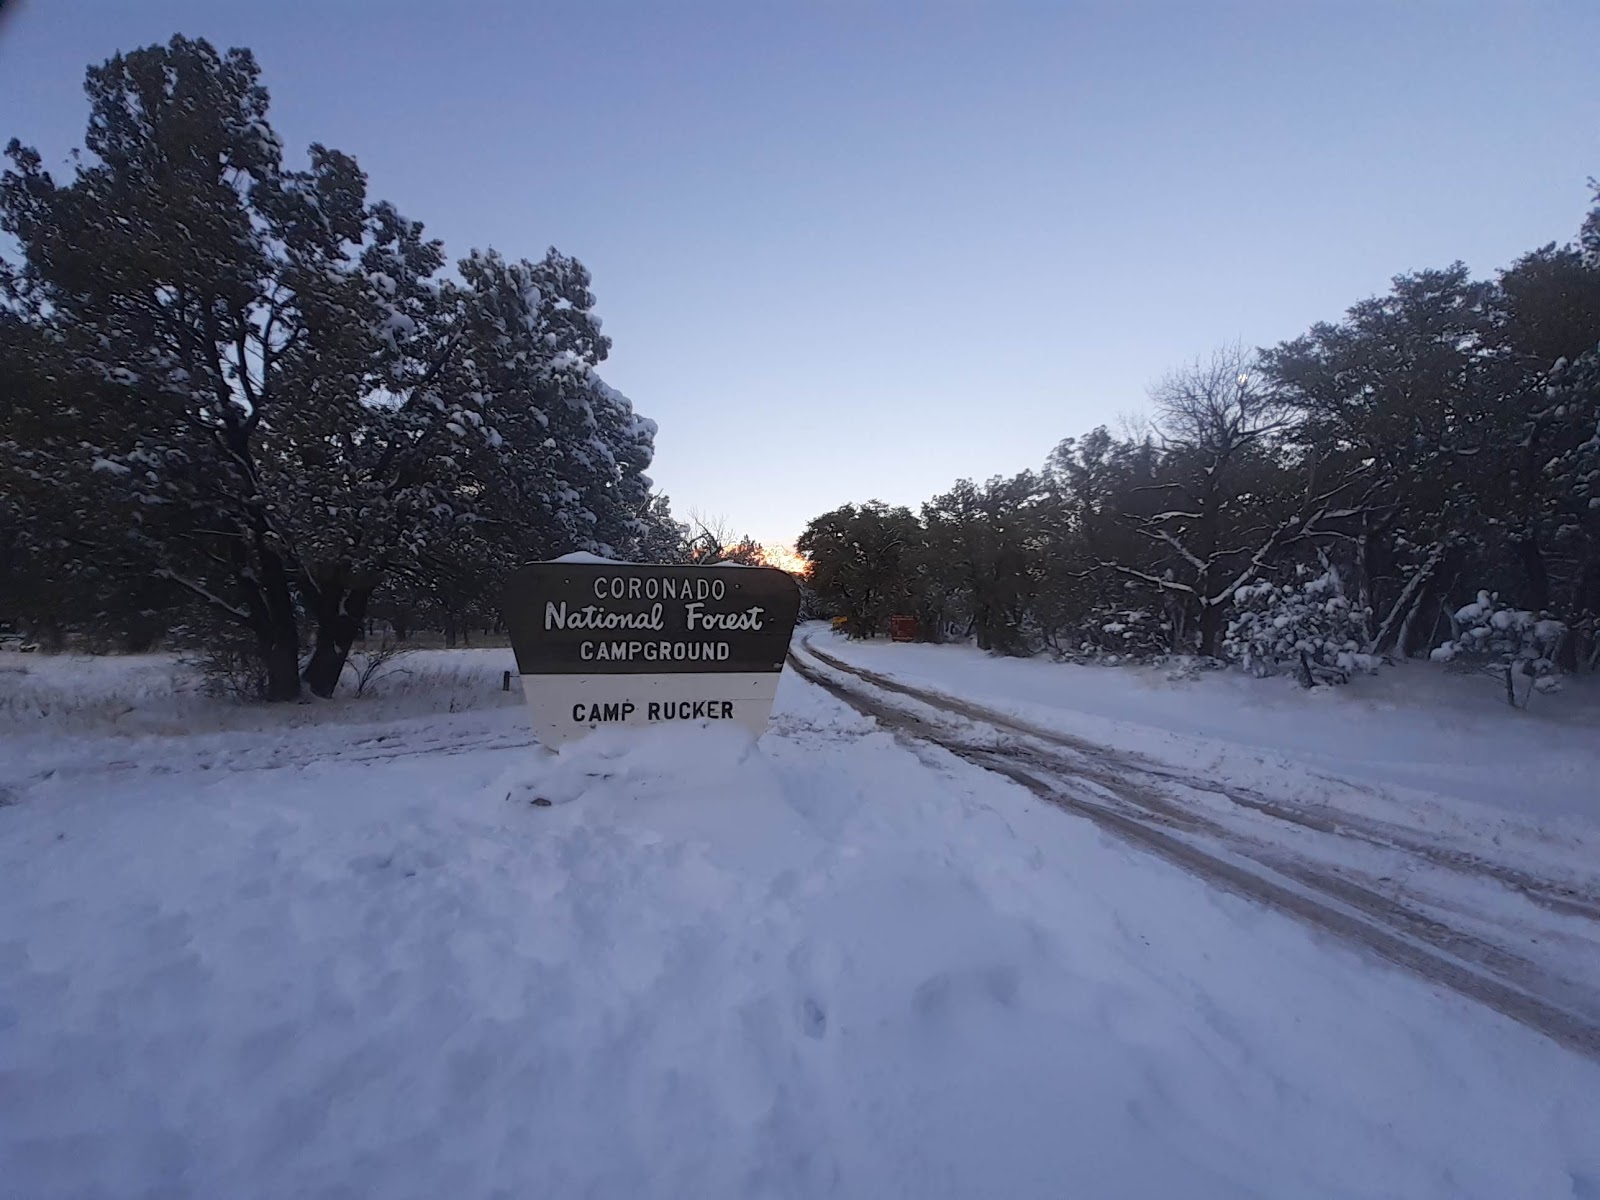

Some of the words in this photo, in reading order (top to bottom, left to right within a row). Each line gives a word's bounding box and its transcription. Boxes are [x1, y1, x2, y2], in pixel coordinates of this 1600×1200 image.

[594, 577, 725, 600] CORONADO
[545, 601, 664, 630] National
[685, 603, 764, 630] Forest
[580, 641, 730, 660] CAMPGROUND
[573, 703, 635, 722] CAMP
[648, 701, 733, 720] RUCKER
